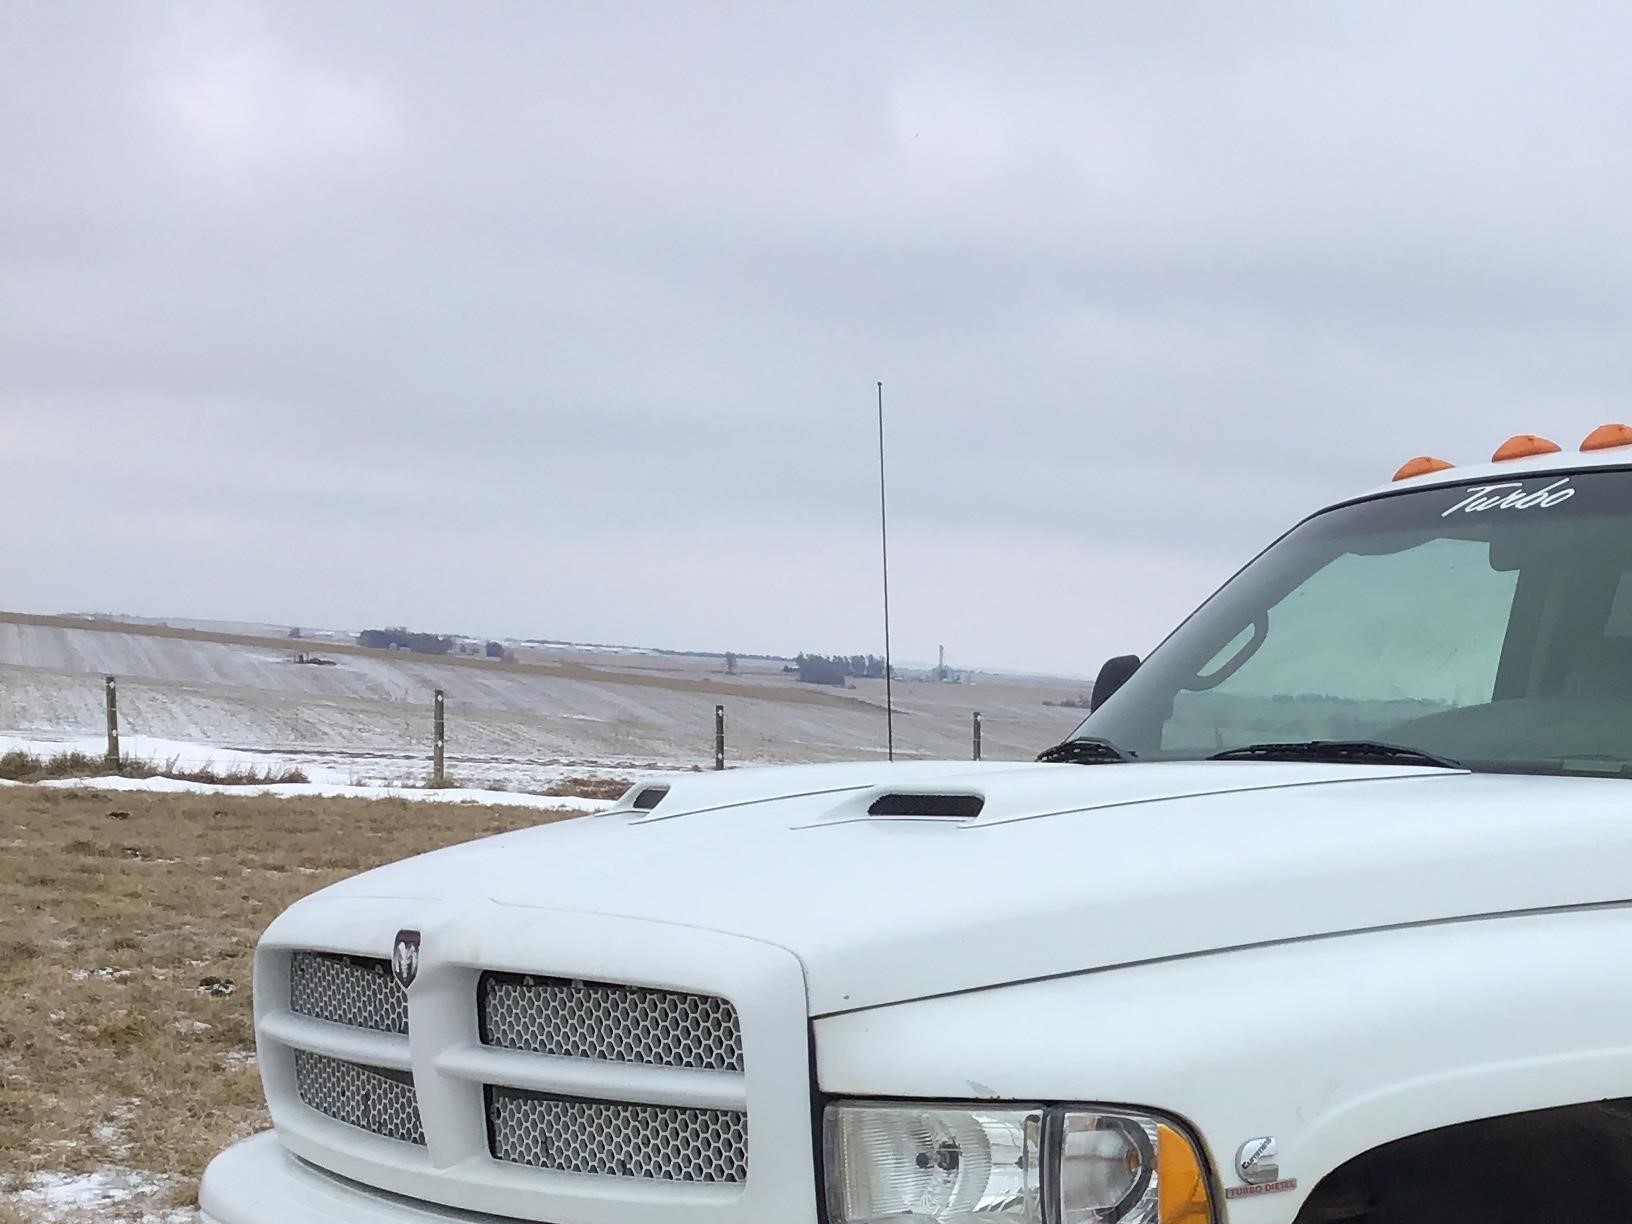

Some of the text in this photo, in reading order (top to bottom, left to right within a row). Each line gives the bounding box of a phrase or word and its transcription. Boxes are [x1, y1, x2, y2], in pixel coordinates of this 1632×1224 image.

[1440, 476, 1577, 518] Turbo
[1241, 1136, 1272, 1170] Cummins
[1230, 1180, 1296, 1197] TURBO DIESEL
